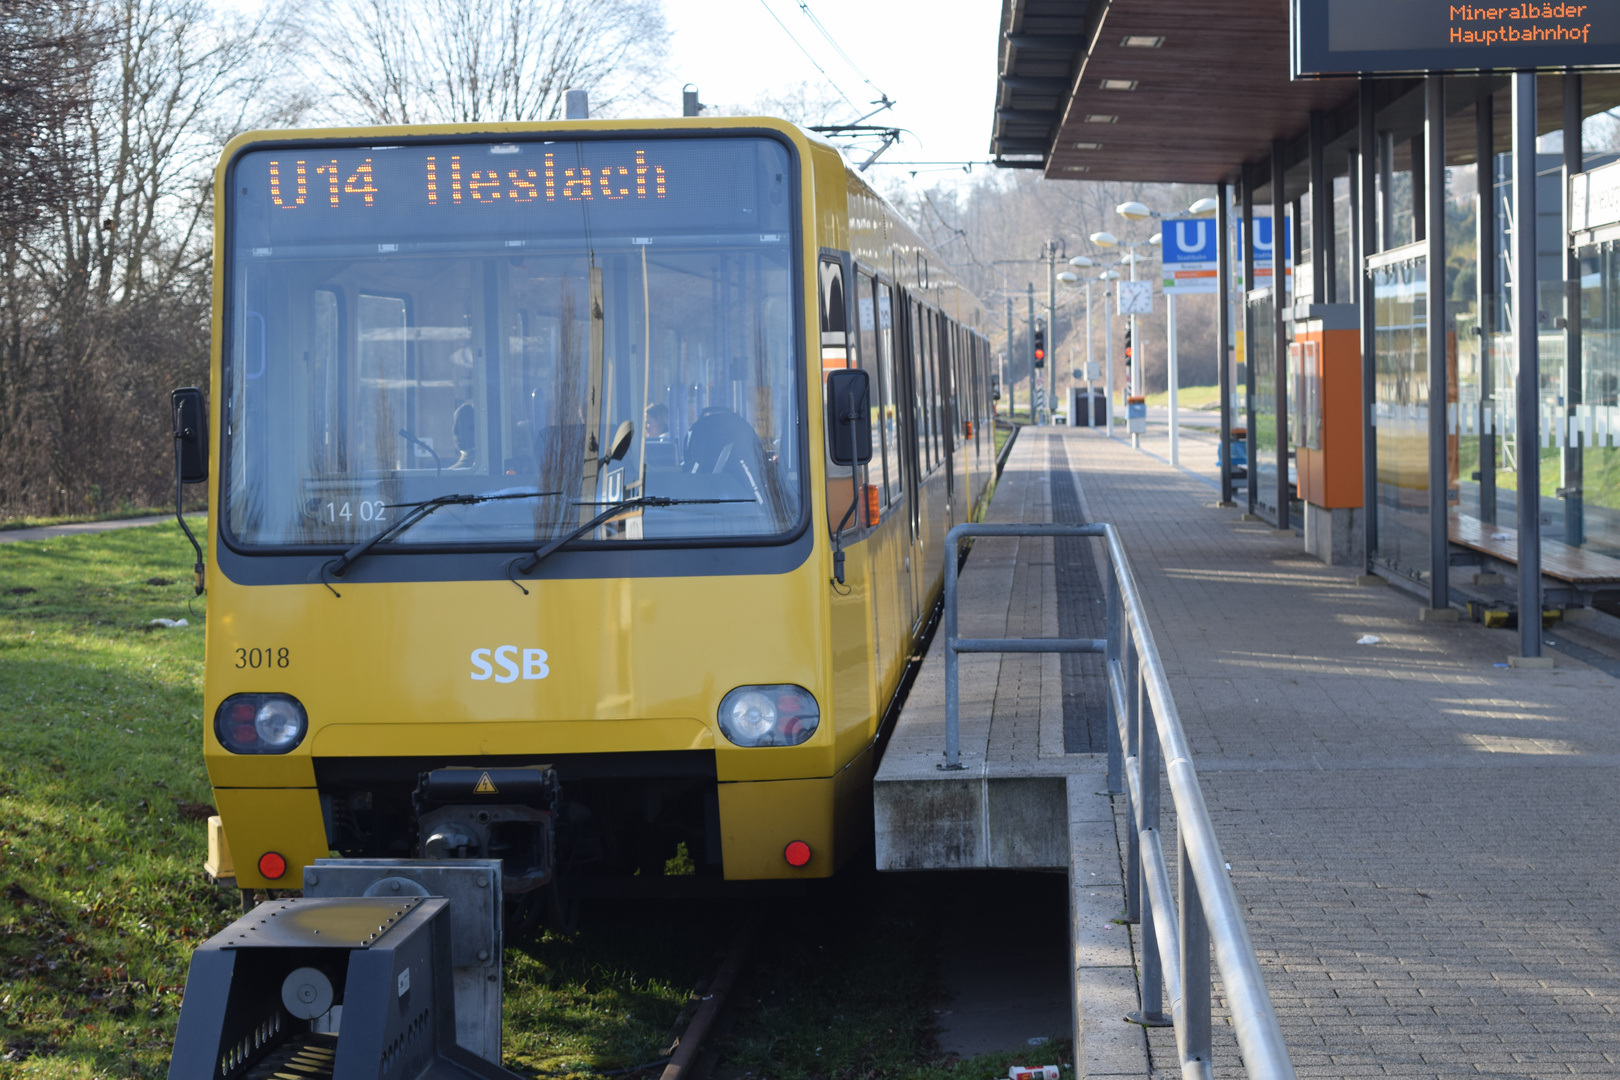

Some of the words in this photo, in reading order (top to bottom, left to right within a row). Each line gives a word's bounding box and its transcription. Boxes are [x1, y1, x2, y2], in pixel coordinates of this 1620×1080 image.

[1450, 2, 1587, 20] Mineralbäder
[1450, 24, 1591, 45] Hauptbahnhof
[270, 159, 378, 208] U14
[1176, 221, 1206, 253] U
[327, 501, 353, 523] 14
[359, 500, 387, 522] 02
[235, 647, 291, 669] 3018
[470, 645, 549, 683] SSB
